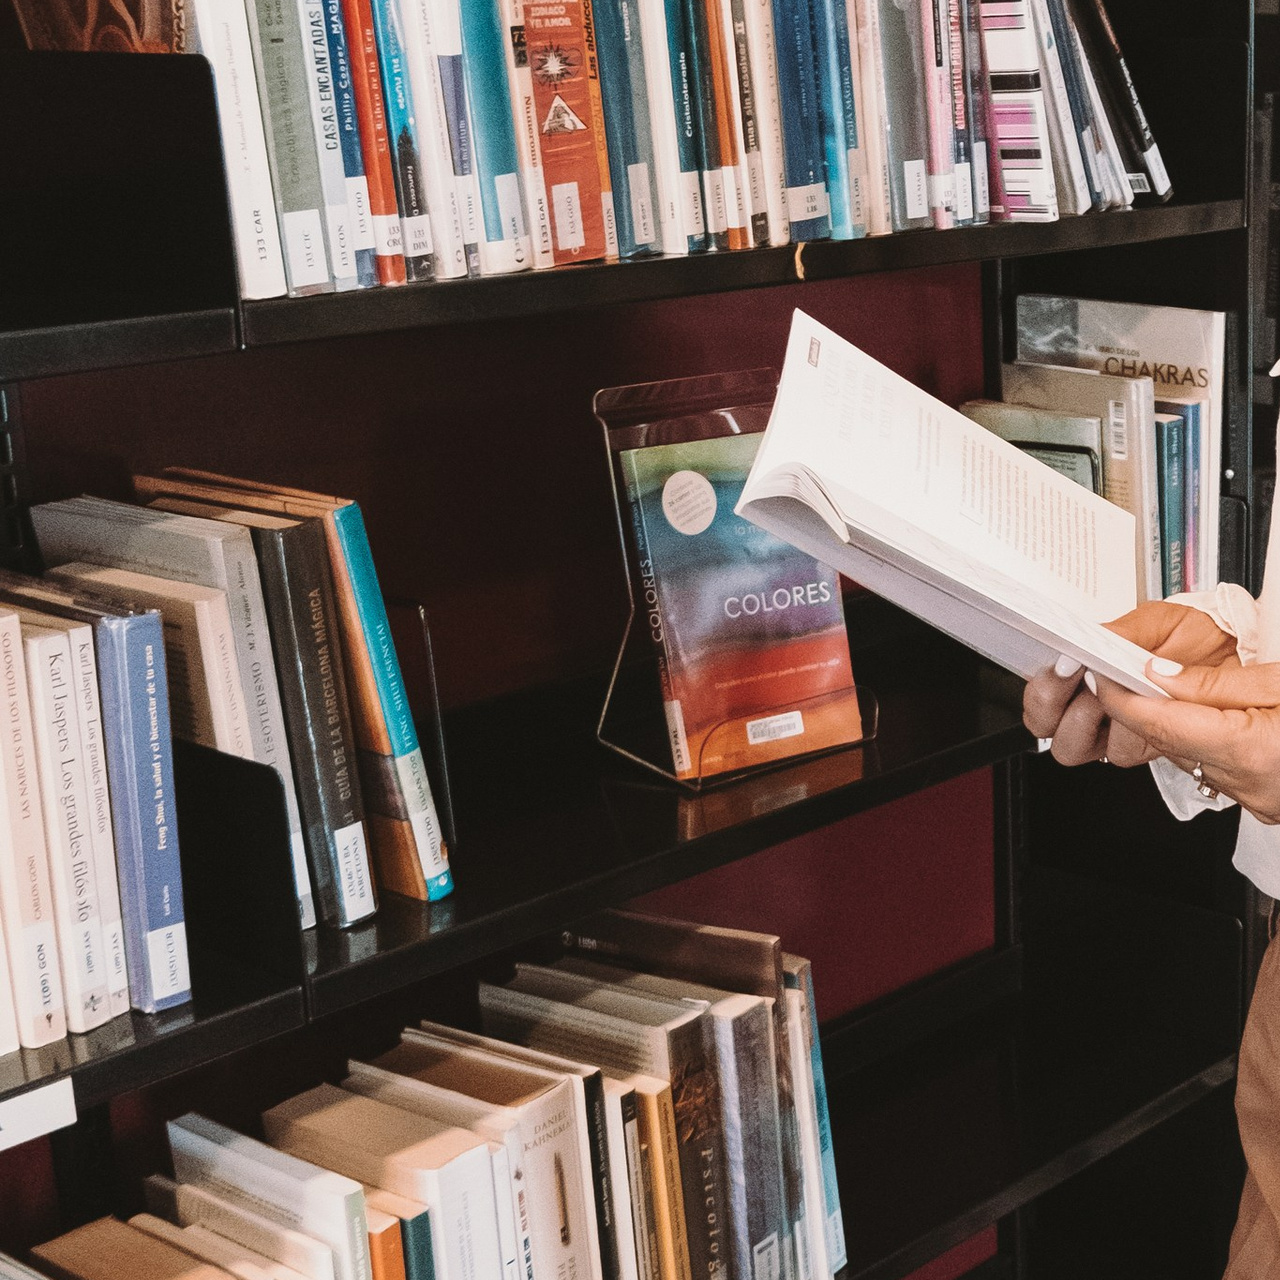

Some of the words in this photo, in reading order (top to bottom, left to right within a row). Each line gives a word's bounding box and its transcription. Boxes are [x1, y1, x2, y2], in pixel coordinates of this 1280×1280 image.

[618, 2, 631, 40] Lorenzo
[310, 10, 332, 101] ENCANTADAS
[335, 45, 348, 88] Cooper
[586, 55, 599, 80] Las
[737, 42, 750, 94] resolver
[678, 52, 693, 137] Cristaloterapia
[341, 93, 353, 130] Phillip
[322, 107, 339, 151] CASAS
[252, 209, 263, 234] CAR
[537, 198, 547, 221] GAR
[256, 238, 266, 260] 133
[303, 231, 312, 249] CIC
[337, 225, 347, 250] CON
[1105, 357, 1209, 388] CHAKRAS
[235, 560, 247, 589] Alonso
[306, 587, 327, 643] MÁGICA
[640, 559, 664, 642] COLORES
[725, 582, 831, 618] COLORES
[77, 643, 92, 667] Karl
[143, 645, 153, 666] casa
[47, 653, 68, 690] Karl
[144, 670, 154, 680] tu
[145, 682, 155, 693] de
[314, 646, 338, 724] BARCELONA
[79, 670, 97, 711] Jaspers
[50, 693, 75, 752] Jaspers
[145, 696, 160, 740] bienestar
[251, 660, 275, 754] ESOTERISMO
[86, 720, 99, 741] Los
[328, 727, 341, 744] LA
[15, 747, 28, 796] NARICES
[87, 743, 104, 785] grandes
[331, 747, 344, 764] DE
[60, 760, 77, 790] Los
[152, 763, 164, 786] salud
[332, 768, 350, 801] GUÍA
[154, 788, 165, 797] la
[61, 794, 84, 858] grandes
[92, 788, 109, 833] filósofos
[155, 800, 168, 825] Shui,
[156, 827, 169, 850] Feng
[35, 943, 46, 969] GON
